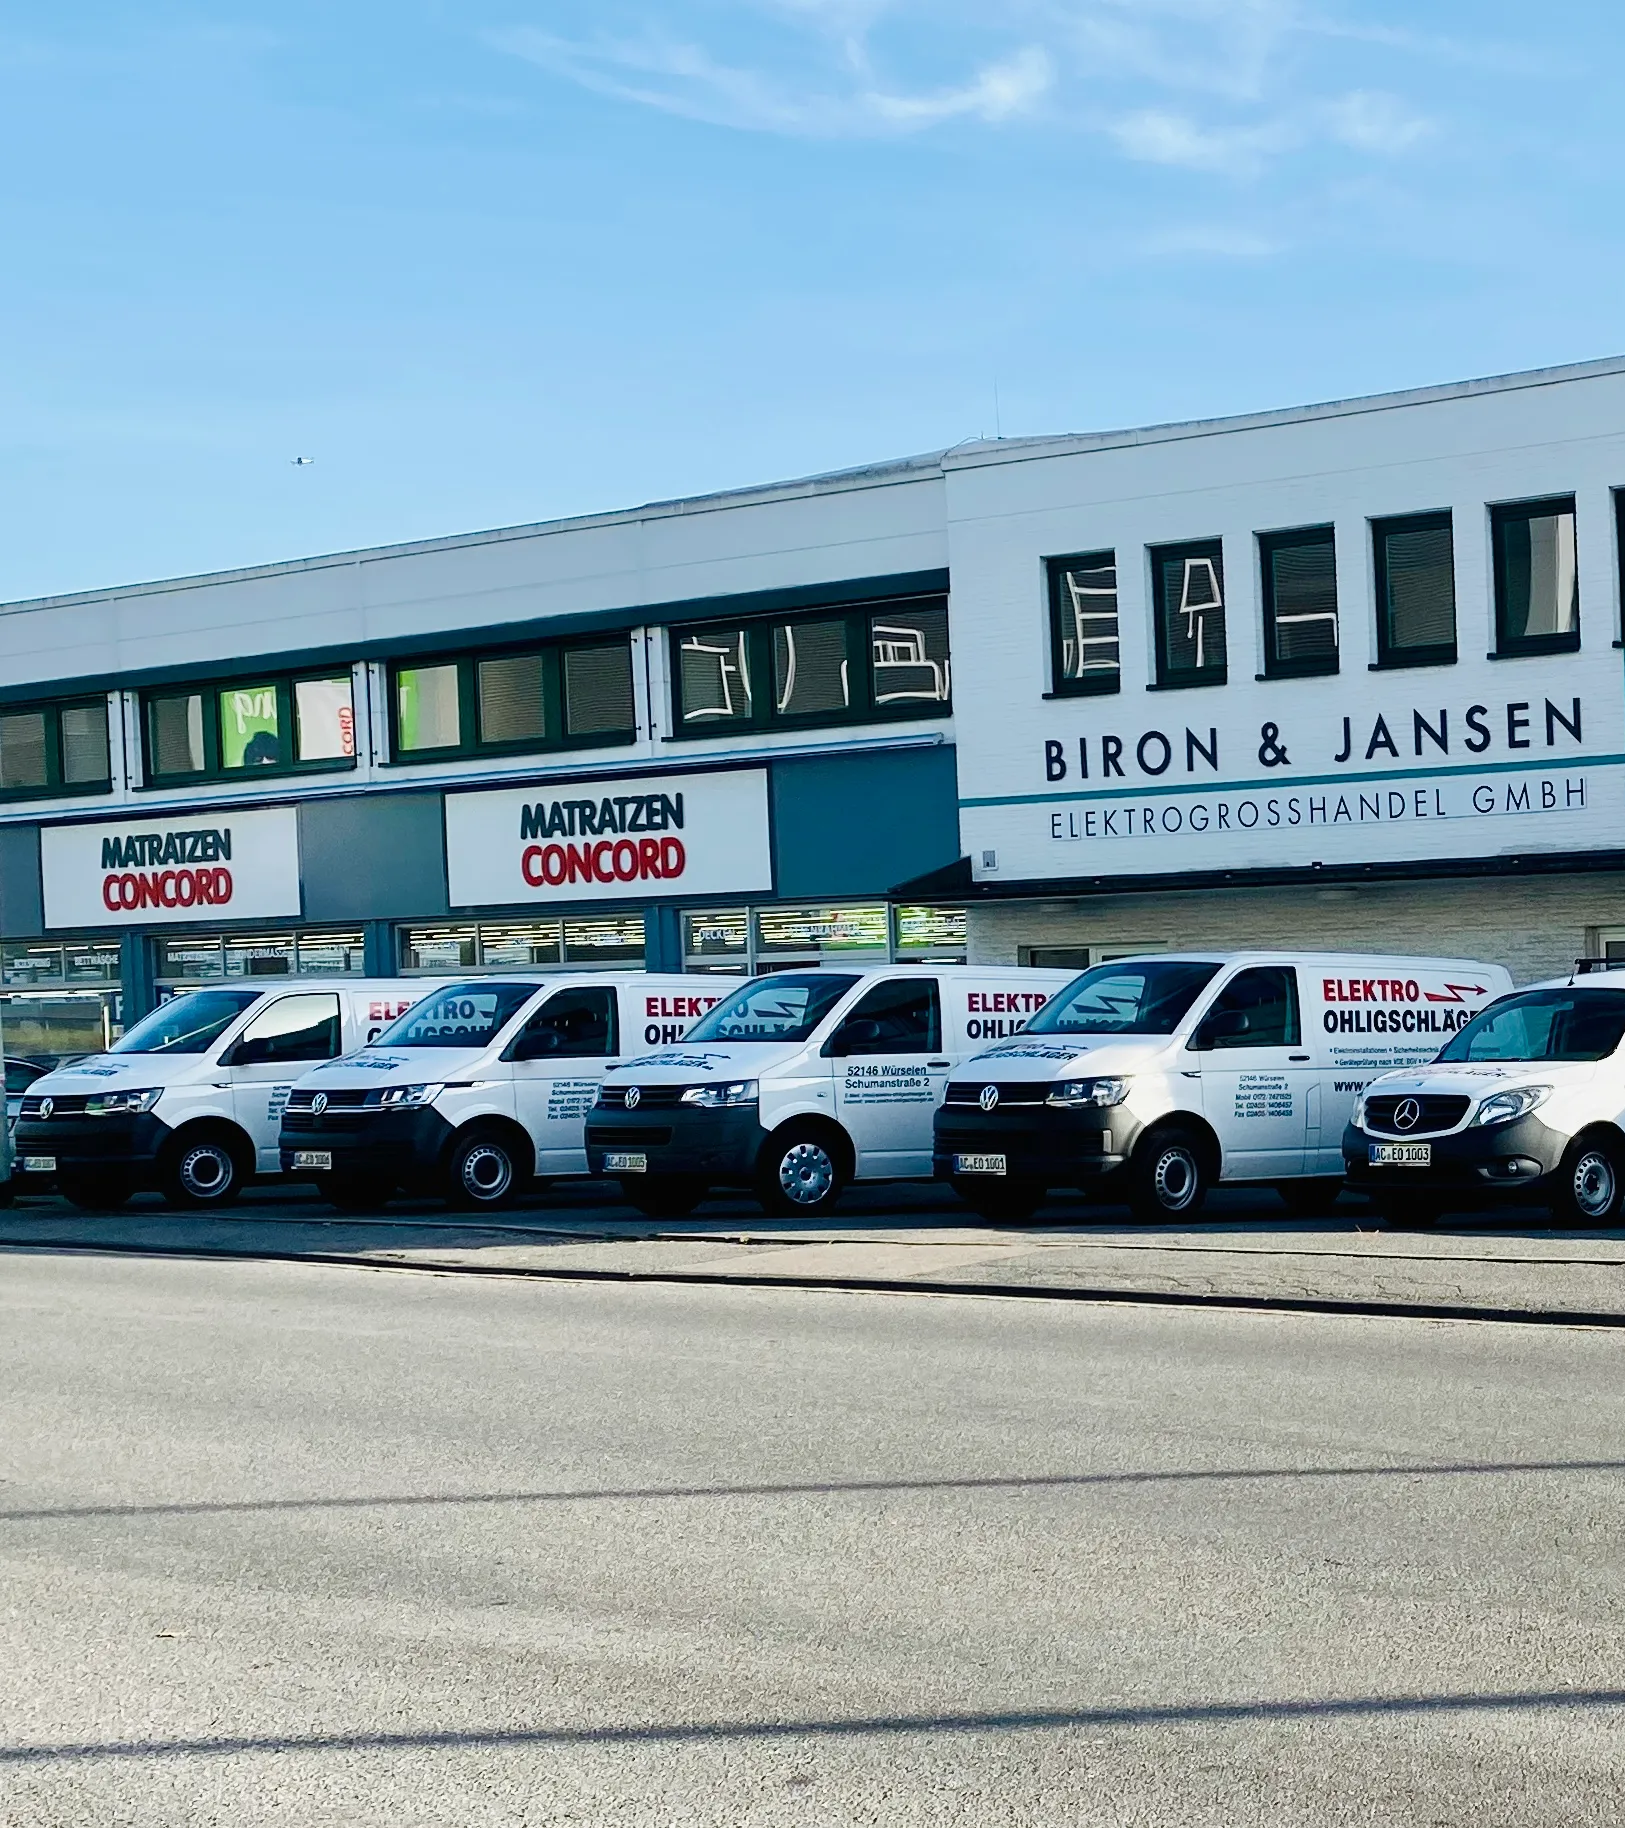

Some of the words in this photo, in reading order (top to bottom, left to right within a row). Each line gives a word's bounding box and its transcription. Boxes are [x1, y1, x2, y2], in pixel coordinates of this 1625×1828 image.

[1044, 727, 1221, 782] BIRON
[1258, 721, 1292, 767] &
[1333, 697, 1583, 763] JANSEN
[521, 792, 684, 839] MATRATZEN
[1051, 789, 1446, 839] ELEKTROGROSSHANDEL
[1473, 778, 1585, 814] GMBH
[101, 829, 231, 868] MATRATZEN
[521, 836, 685, 887] CONCORD
[103, 867, 233, 911] CONCORD
[1323, 979, 1420, 1002] ELEKTRO
[845, 1078, 921, 1089] Schumanstraße
[923, 1077, 930, 1087] 2
[847, 1065, 879, 1076] 52146
[881, 1065, 927, 1076] Würselen
[960, 1157, 969, 1169] AC
[973, 1157, 983, 1169] EO
[985, 1157, 1005, 1169] 1001
[1375, 1148, 1386, 1160] AC
[1392, 1148, 1404, 1160] EO
[1405, 1148, 1429, 1160] 1003
